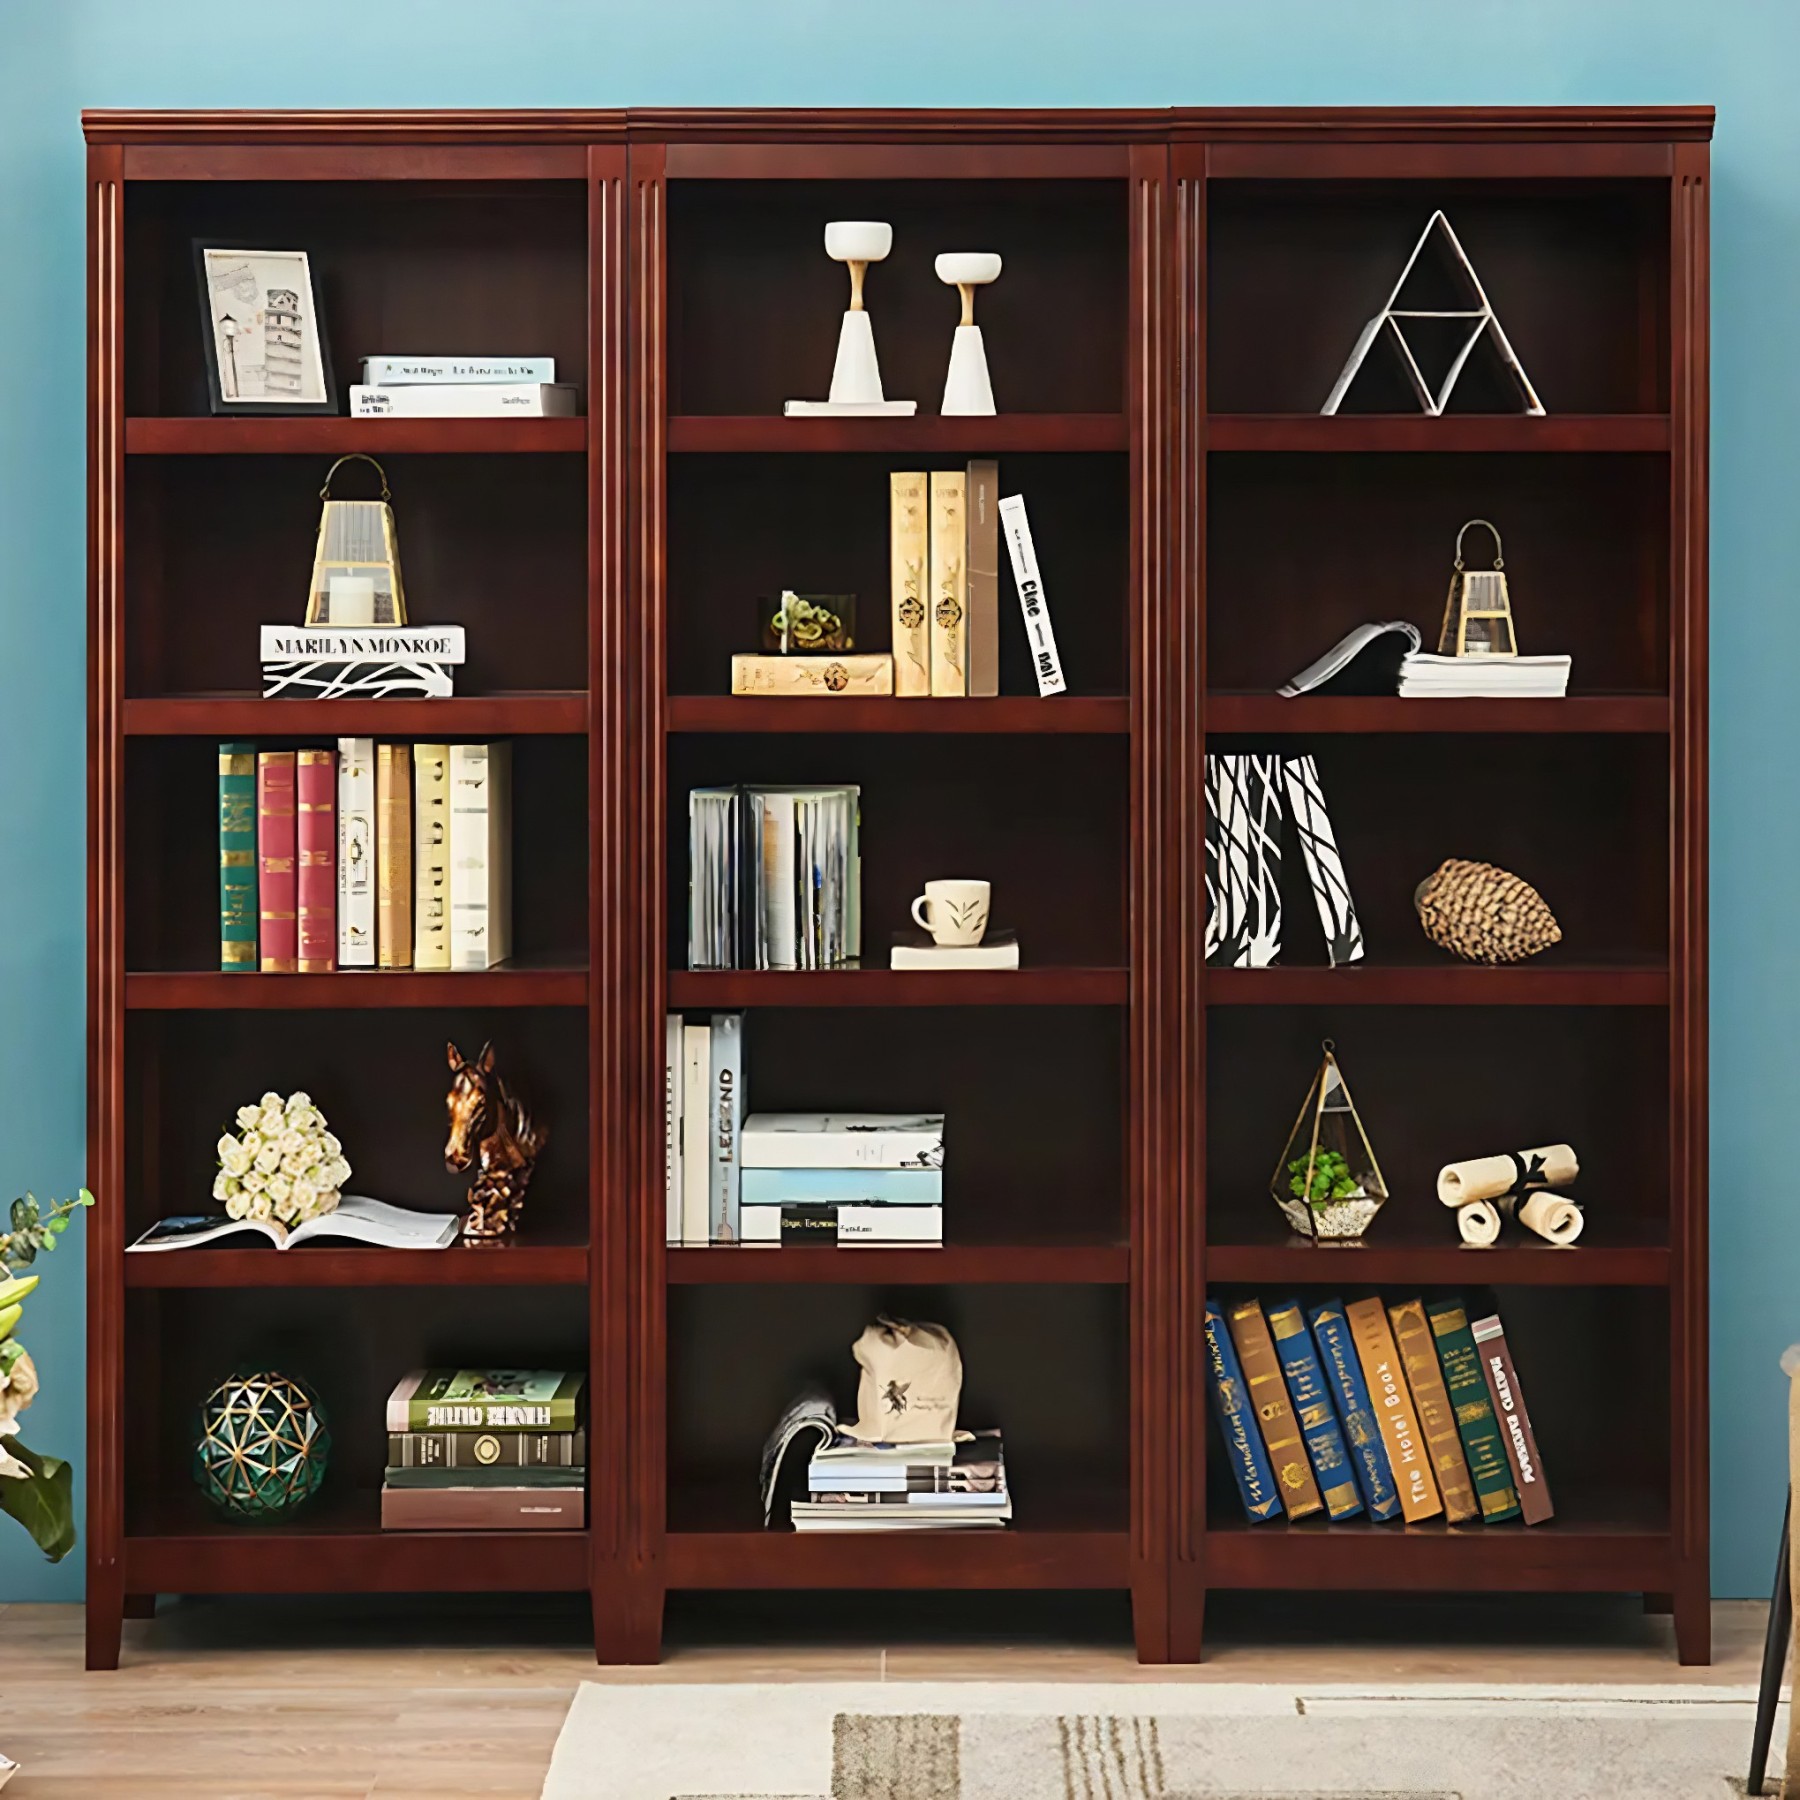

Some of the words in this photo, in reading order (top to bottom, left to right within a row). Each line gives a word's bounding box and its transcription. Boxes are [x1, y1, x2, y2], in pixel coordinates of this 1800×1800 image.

[274, 637, 364, 655] MARILYN
[368, 637, 451, 655] MONROE
[718, 1068, 733, 1164] LEGEND
